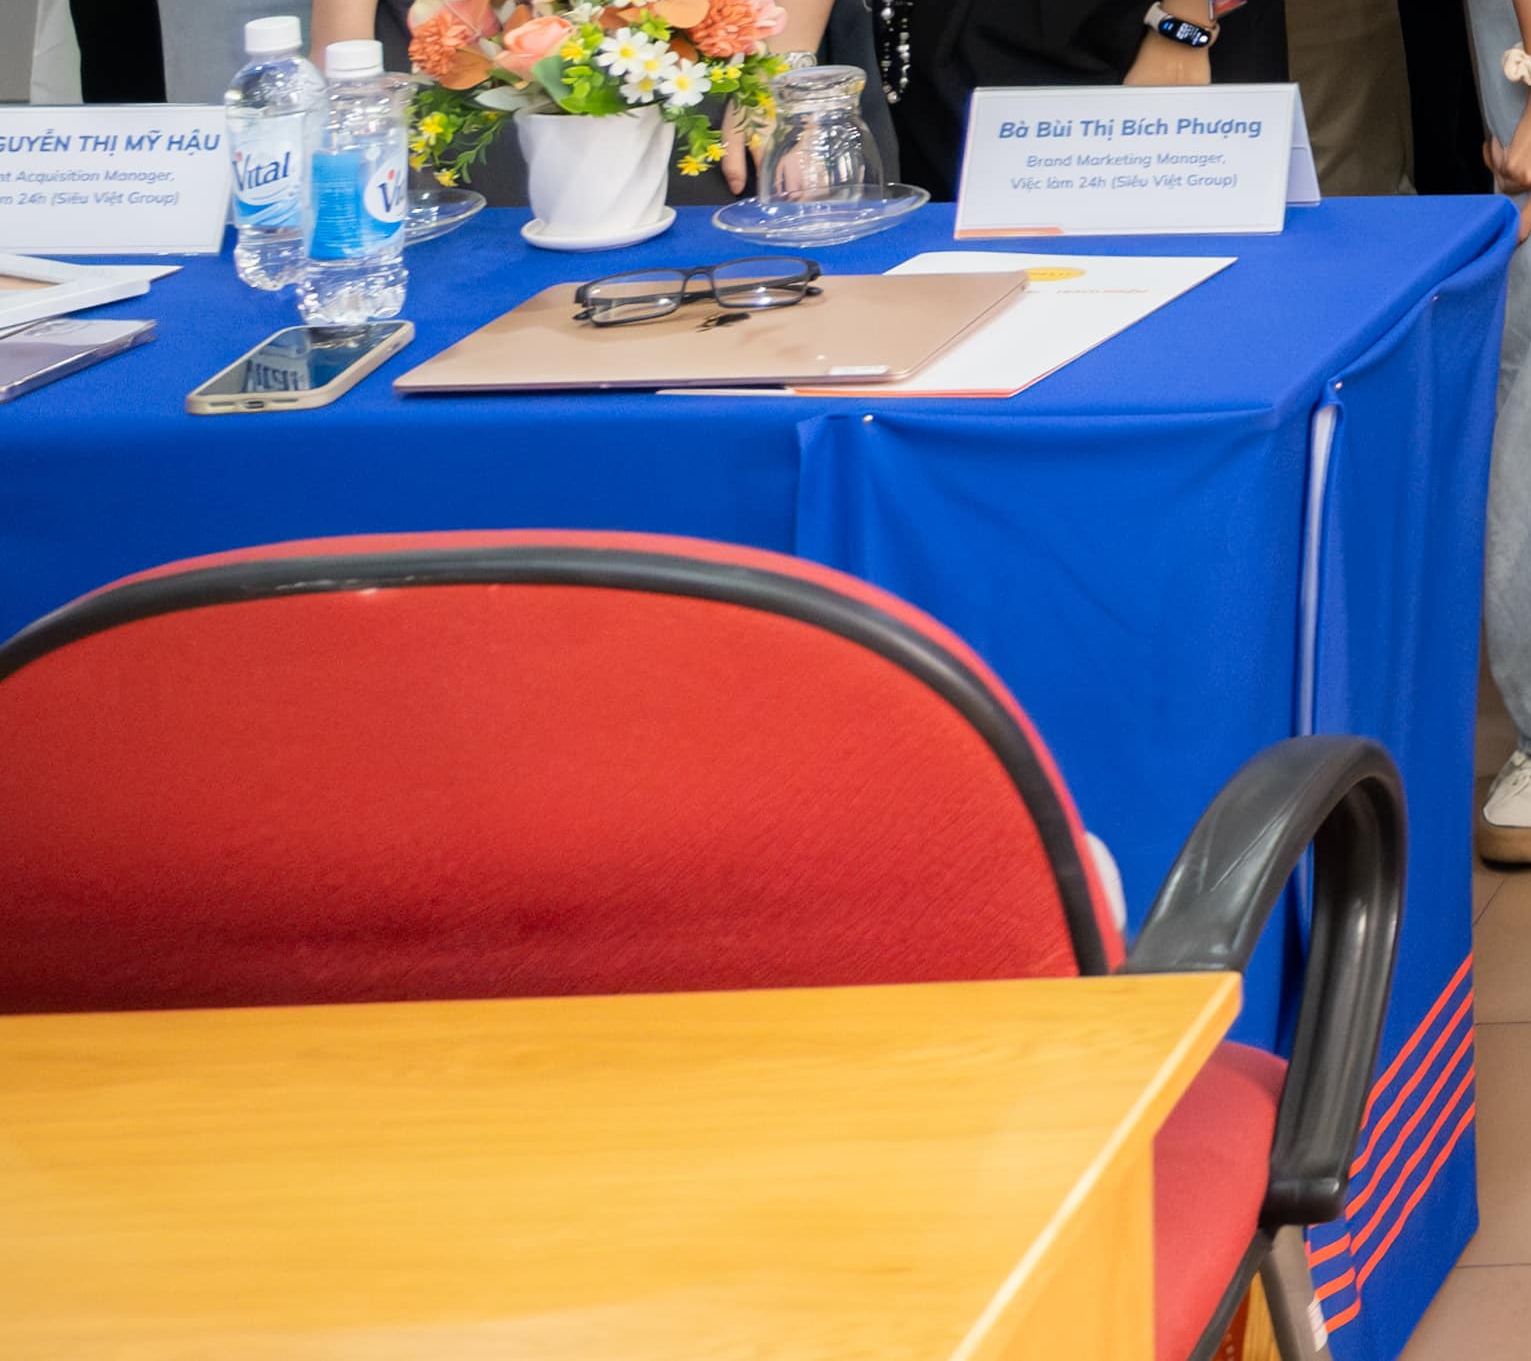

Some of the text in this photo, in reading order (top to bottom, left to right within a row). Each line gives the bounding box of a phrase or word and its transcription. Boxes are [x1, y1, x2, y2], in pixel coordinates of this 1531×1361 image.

[999, 118, 1262, 141] Bà Bùi Thị Bích Phượng
[78, 135, 118, 156] THỊ
[125, 130, 162, 151] MỸ
[166, 129, 220, 155] HẬU
[1027, 153, 1072, 168] Brand
[1077, 154, 1152, 169] Marketing
[15, 170, 100, 185] Acquisition
[104, 170, 175, 184] Manager,
[232, 152, 290, 191] Vital
[1079, 176, 1106, 189] 24h
